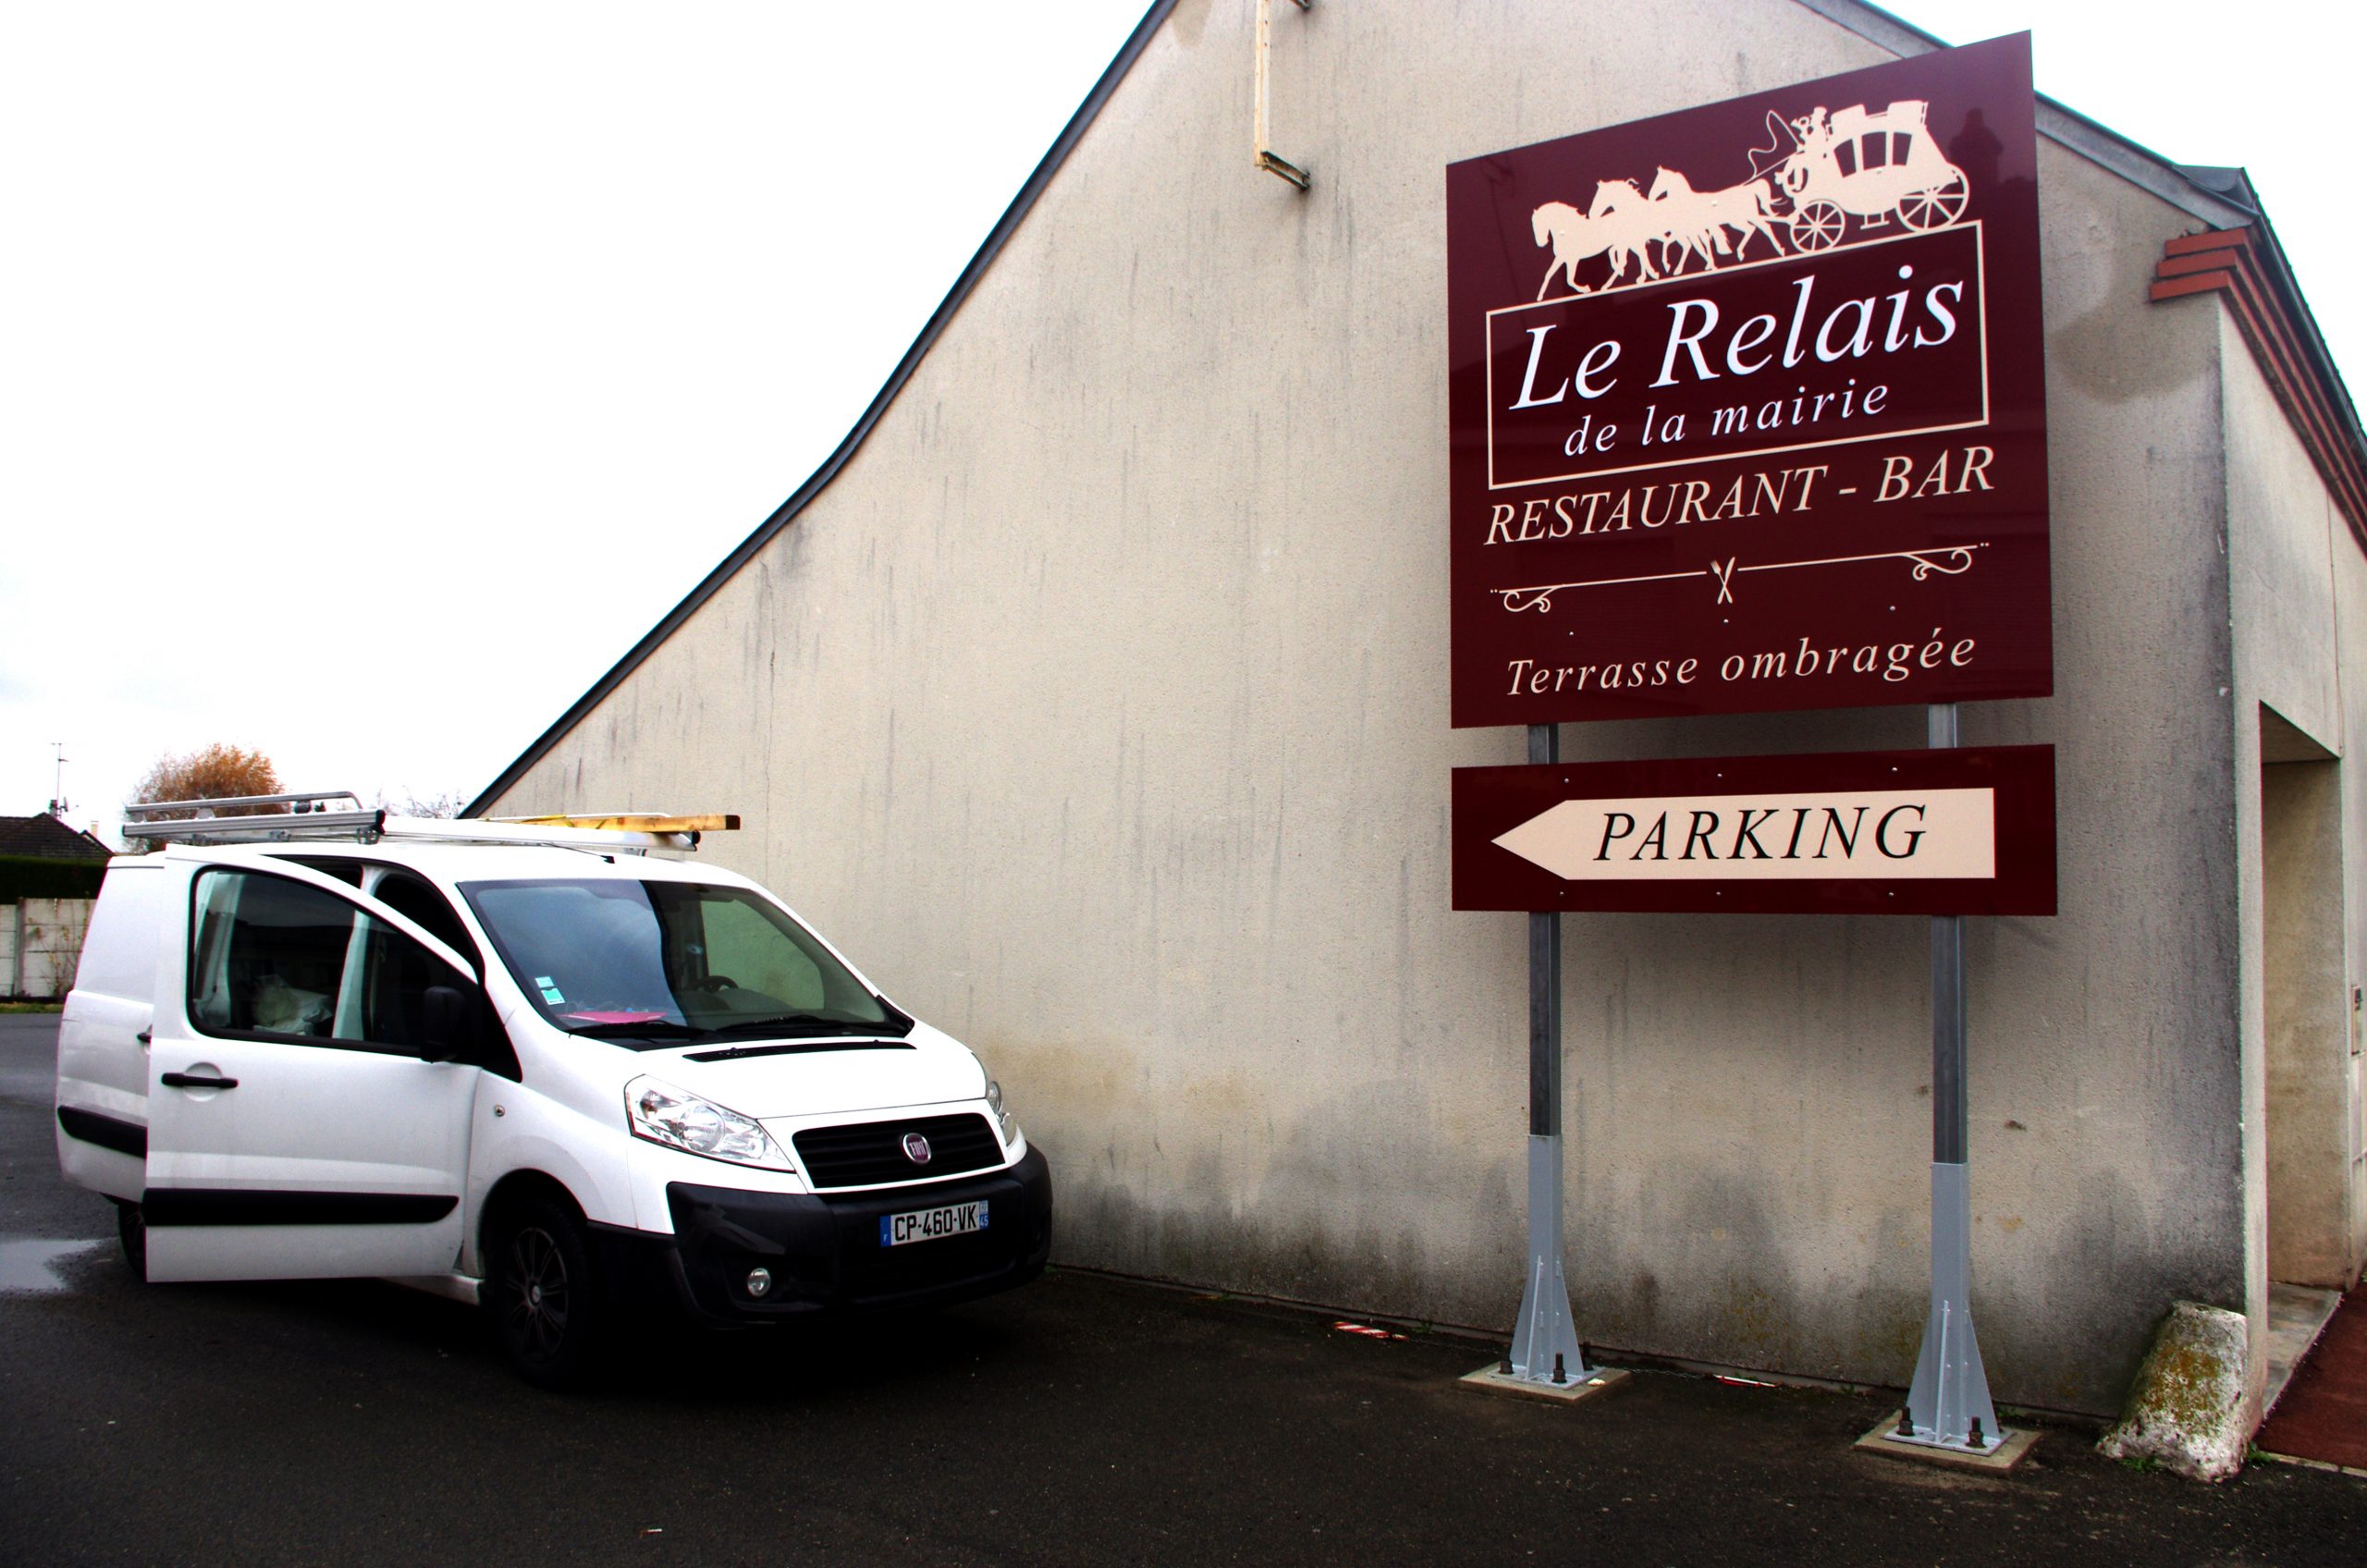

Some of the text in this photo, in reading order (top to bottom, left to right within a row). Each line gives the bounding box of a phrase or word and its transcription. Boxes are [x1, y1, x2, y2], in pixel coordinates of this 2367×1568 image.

[1509, 265, 1963, 410] Le Relais
[1565, 379, 1887, 456] de la mairie
[1484, 466, 1828, 545] RESTAURANT
[1874, 447, 1993, 502] BAR
[1509, 628, 1974, 694] Terrasse ombragée
[1593, 805, 1926, 861] PARKING
[980, 1215, 988, 1227] 45
